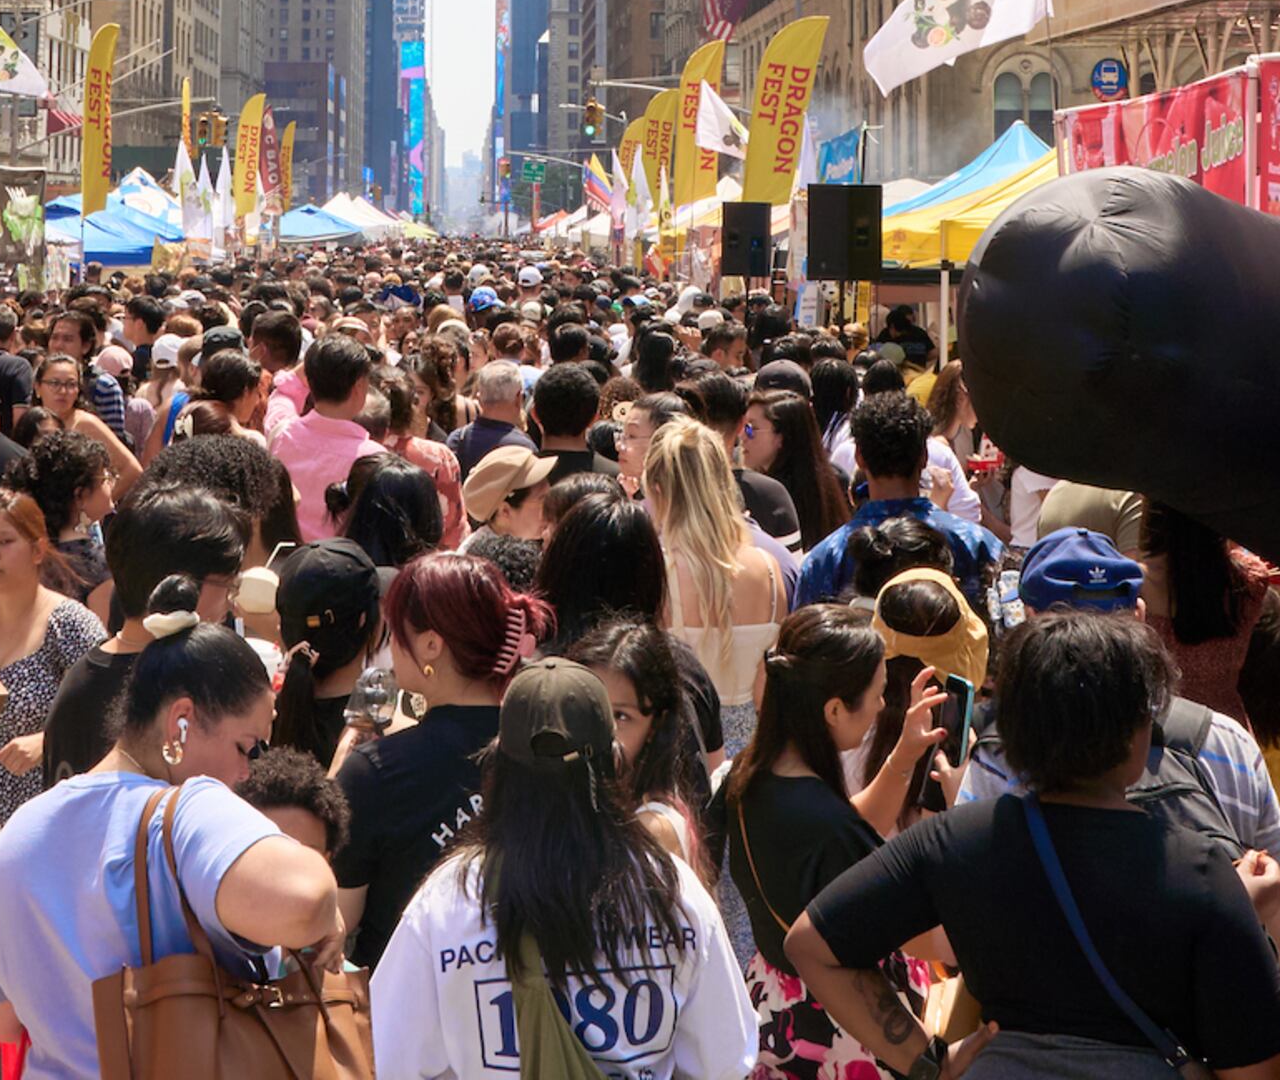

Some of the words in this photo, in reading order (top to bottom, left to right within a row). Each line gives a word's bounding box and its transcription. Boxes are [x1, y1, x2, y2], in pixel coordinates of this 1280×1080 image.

[87, 68, 102, 130] FEST
[682, 81, 699, 135] FEST
[758, 62, 787, 126] FEST
[773, 65, 810, 175] DRAGON
[238, 123, 250, 165] FEST
[243, 124, 260, 195] DRAGON
[646, 119, 660, 160] FEST
[1147, 135, 1198, 178] melon
[1201, 112, 1244, 172] Juice
[431, 793, 484, 848] HAR
[618, 924, 696, 952] WEAR
[489, 979, 664, 1058] 180
